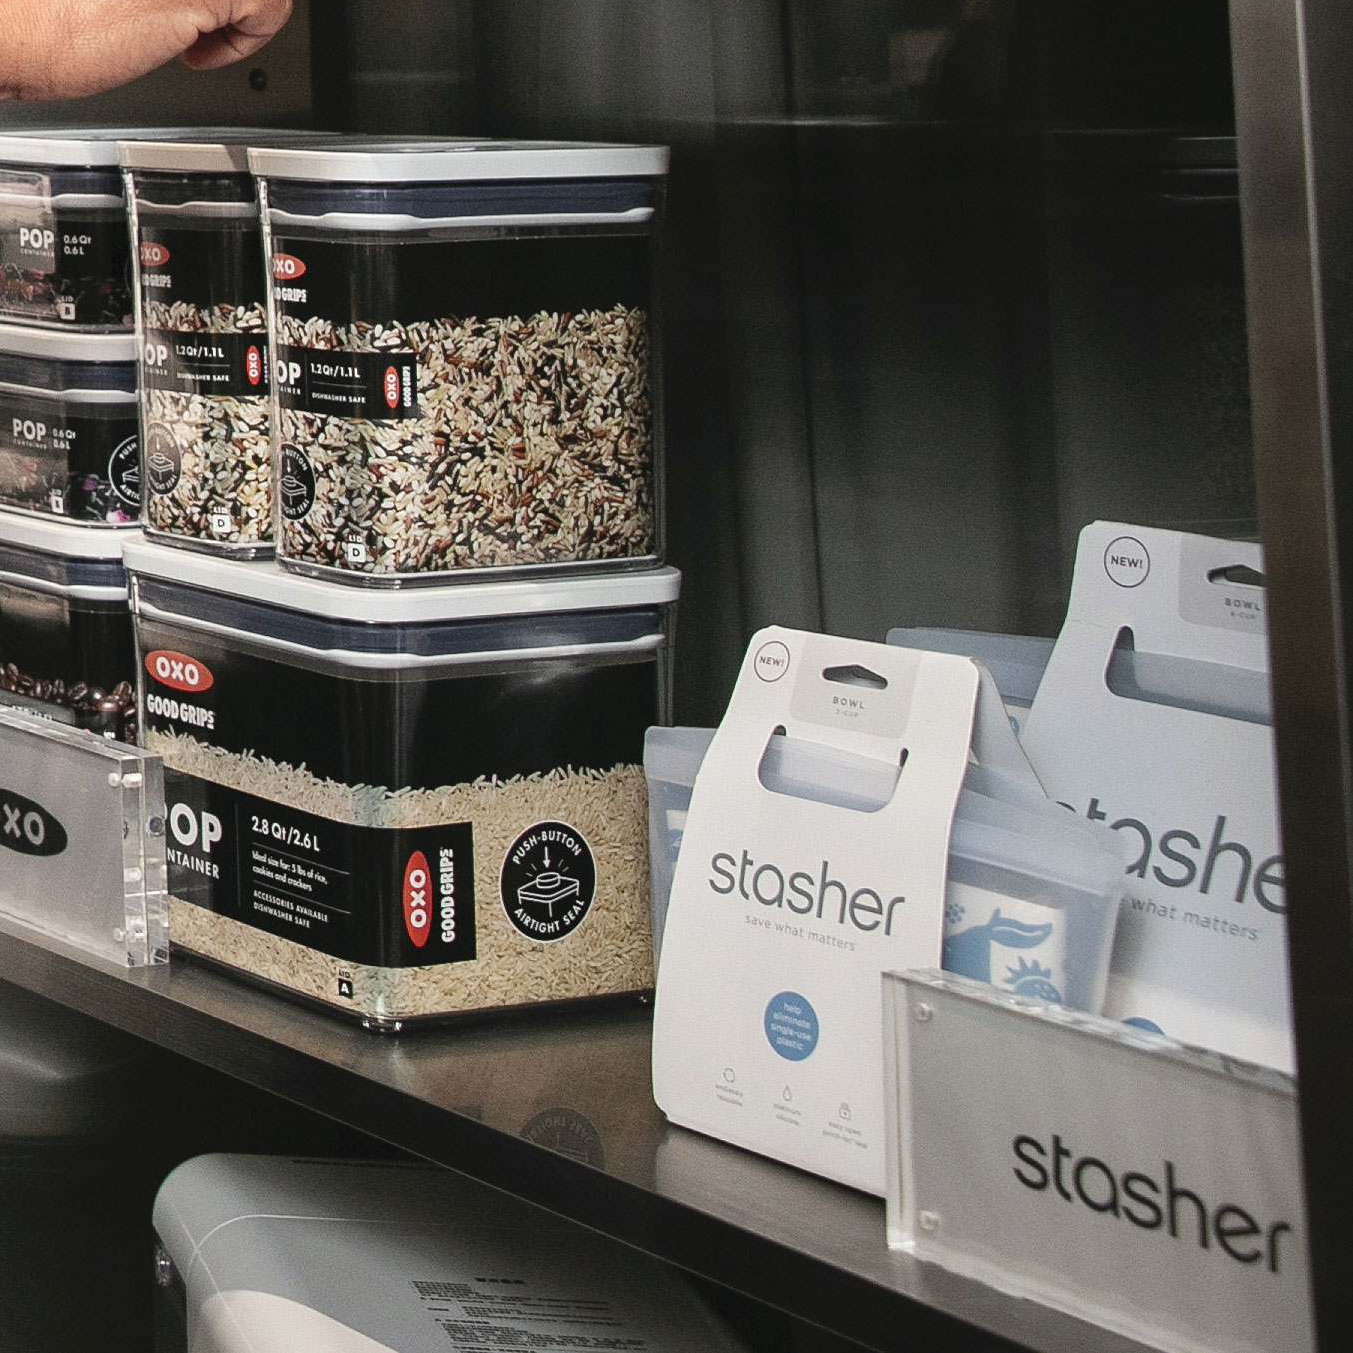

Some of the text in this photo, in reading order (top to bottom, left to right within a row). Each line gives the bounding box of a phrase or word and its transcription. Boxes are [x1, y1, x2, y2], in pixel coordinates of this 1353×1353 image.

[20, 227, 55, 249] POP
[248, 352, 258, 378] OXO
[348, 393, 366, 403] SAFE
[386, 373, 396, 400] OXO
[12, 418, 45, 441] POP
[1110, 554, 1143, 569] NEW!
[1224, 598, 1261, 611] BOWL
[156, 656, 199, 685] OXO
[759, 656, 785, 667] NEW!
[147, 693, 214, 728] GOOD GRIPS
[833, 696, 865, 710] BOWL
[164, 803, 222, 853] OP
[251, 816, 269, 835] 2.8
[512, 830, 583, 865] PUSH-BUTTON
[1056, 797, 1286, 915] ashe
[167, 848, 220, 879] NTAINER
[275, 872, 286, 883] and
[253, 890, 328, 923] ACCESSORIES AVAILABLE
[409, 869, 427, 928] OXO
[440, 848, 455, 943] GOOD GRIPS
[708, 849, 905, 936] stasher
[253, 902, 311, 928] DISHWASHER SAFE
[514, 898, 585, 933] AIRTIGHT SEAL
[1131, 898, 1259, 941] what matters
[745, 913, 855, 951] save what matters
[770, 1023, 812, 1041] single-use
[773, 1012, 811, 1029] eliminate
[776, 1037, 803, 1050] plastic
[1012, 1134, 1292, 1273] stasher
